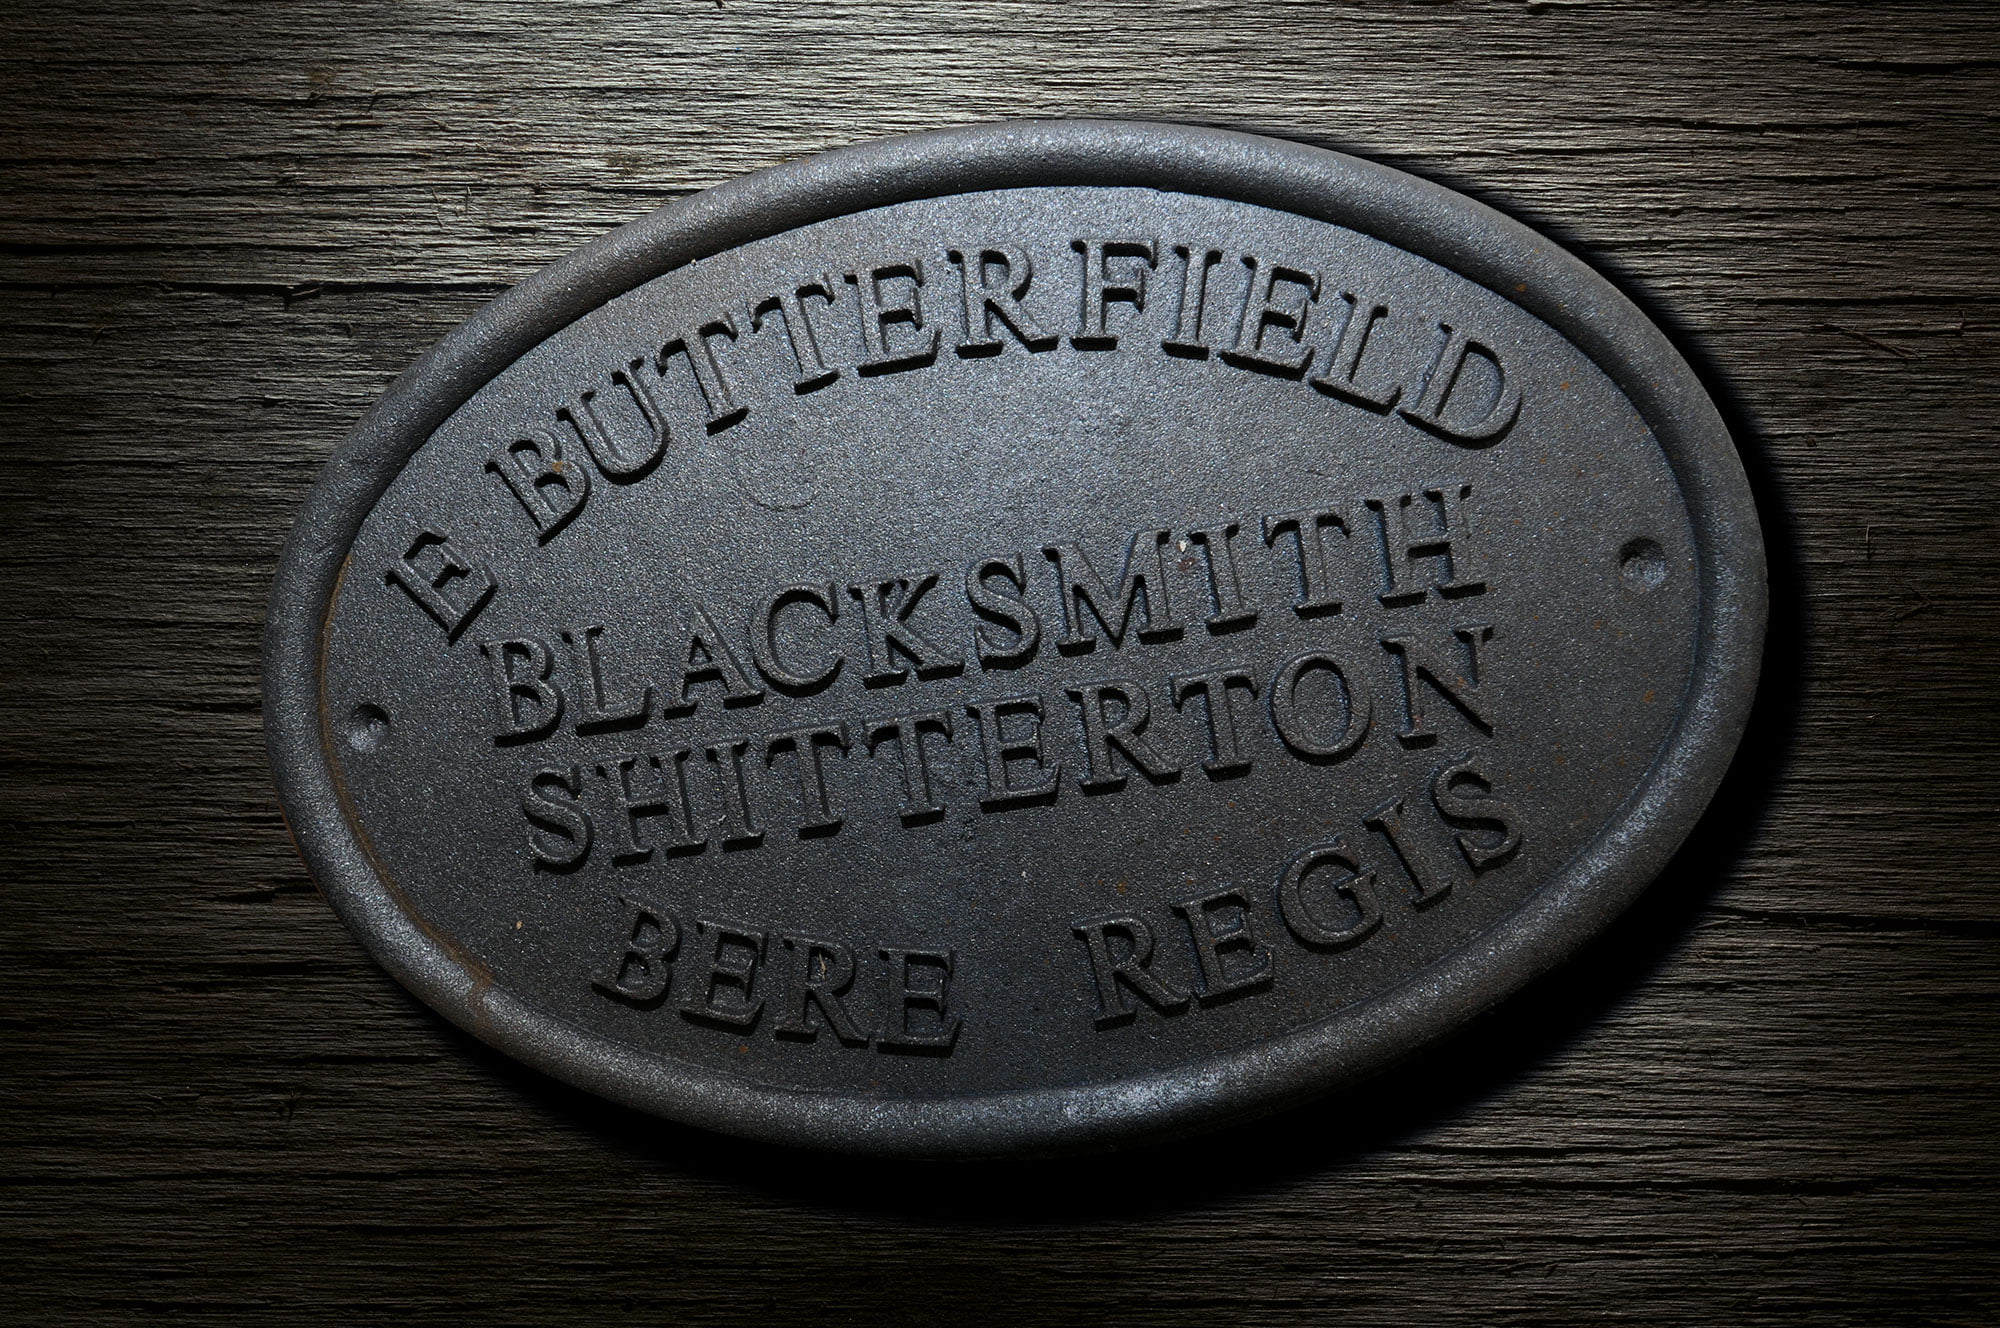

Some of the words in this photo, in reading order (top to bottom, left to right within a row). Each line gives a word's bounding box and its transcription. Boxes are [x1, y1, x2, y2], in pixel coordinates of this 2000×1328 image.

[386, 528, 497, 646] E
[485, 237, 1524, 545] BUTTERFIELD
[482, 483, 1488, 745] BLACKSMITH
[523, 624, 1495, 875] SHITTERTON
[591, 897, 960, 1055] BERE
[1071, 759, 1524, 1031] REGIS
